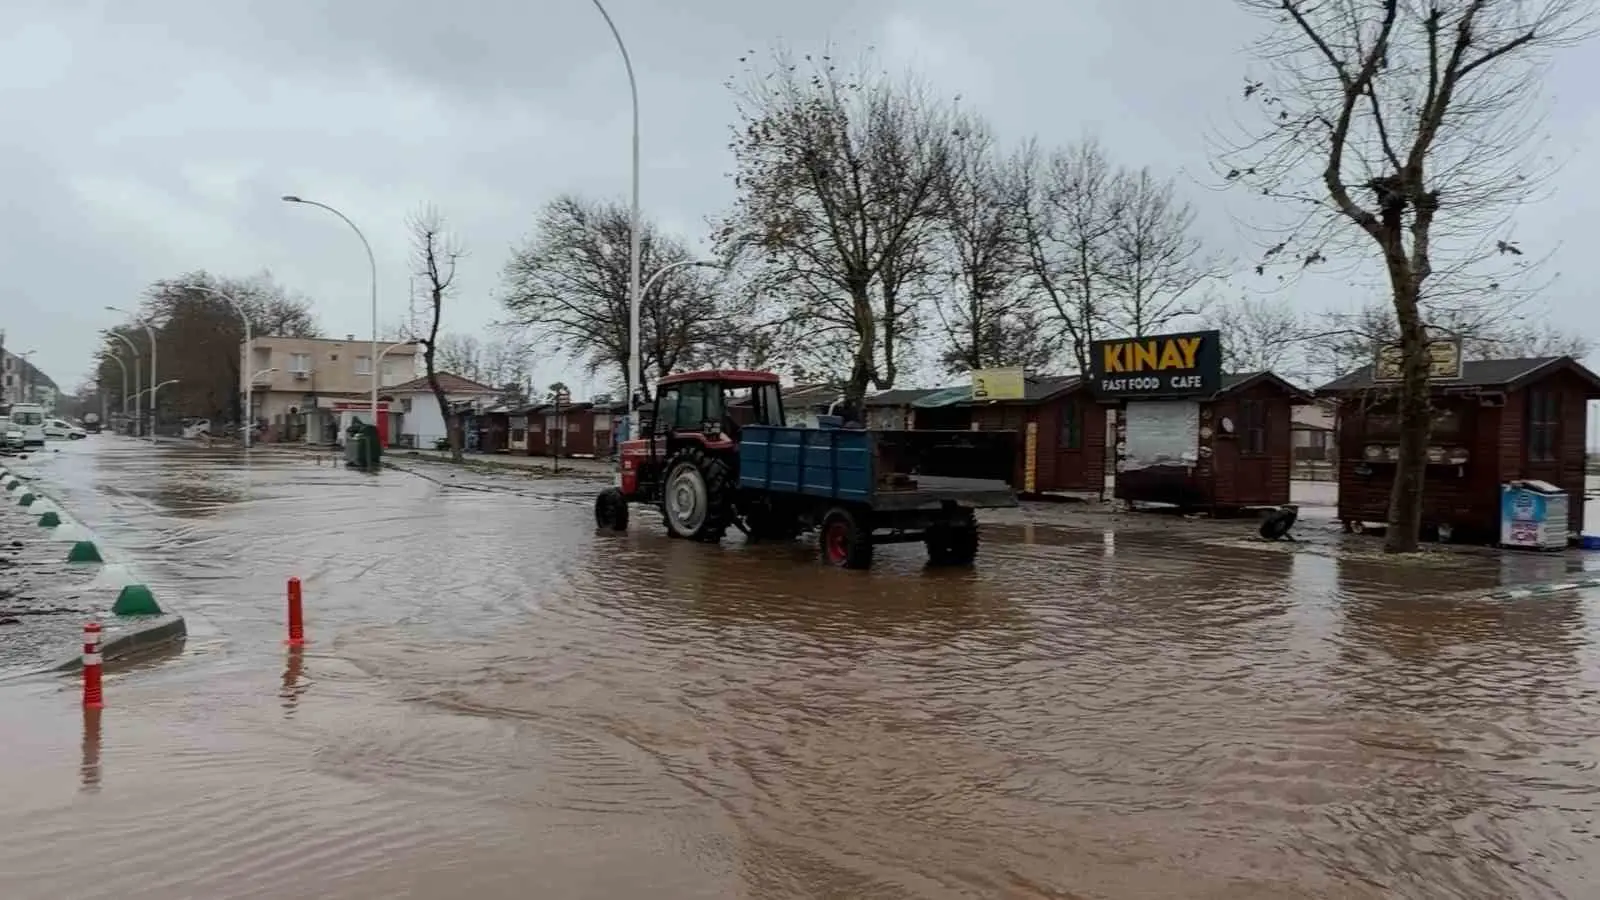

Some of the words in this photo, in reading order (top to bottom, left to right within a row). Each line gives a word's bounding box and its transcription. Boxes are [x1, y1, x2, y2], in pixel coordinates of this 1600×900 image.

[1104, 337, 1202, 372] KINAY
[1102, 379, 1127, 391] FAST
[1129, 377, 1160, 390] FOOD
[1170, 376, 1202, 388] CAFE
